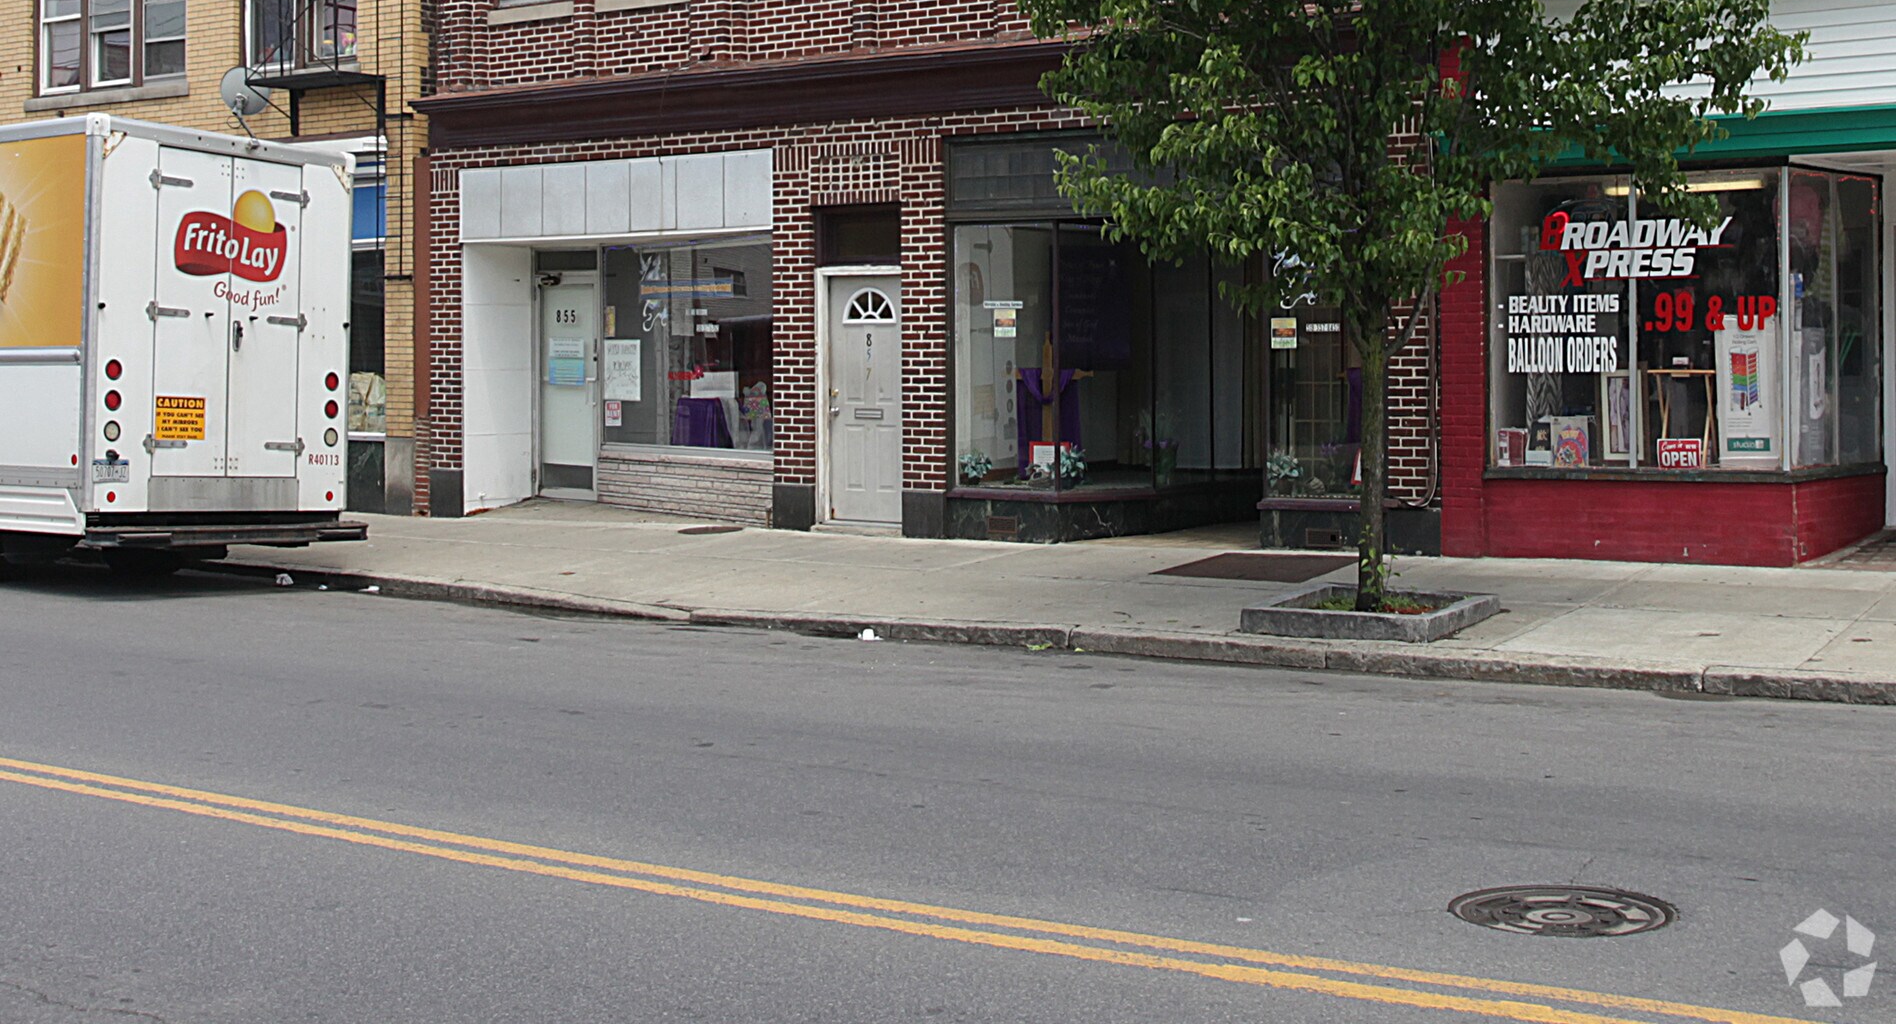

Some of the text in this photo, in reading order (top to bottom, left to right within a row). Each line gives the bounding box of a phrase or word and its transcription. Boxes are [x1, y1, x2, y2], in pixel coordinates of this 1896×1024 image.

[1540, 211, 1733, 250] BROADWAY
[1559, 247, 1696, 288] XPRESS
[214, 281, 280, 312] Good fun!
[1508, 294, 1619, 314] BEAUTY ITEMS
[556, 310, 576, 323] 855
[1644, 292, 1777, 332] .99 & UP
[1508, 314, 1597, 333] HARDWARE
[1508, 337, 1617, 373] BALLOON ORDERS
[157, 398, 203, 409] CAUTION
[308, 454, 339, 466] R40113
[1661, 451, 1697, 467] OPEN
